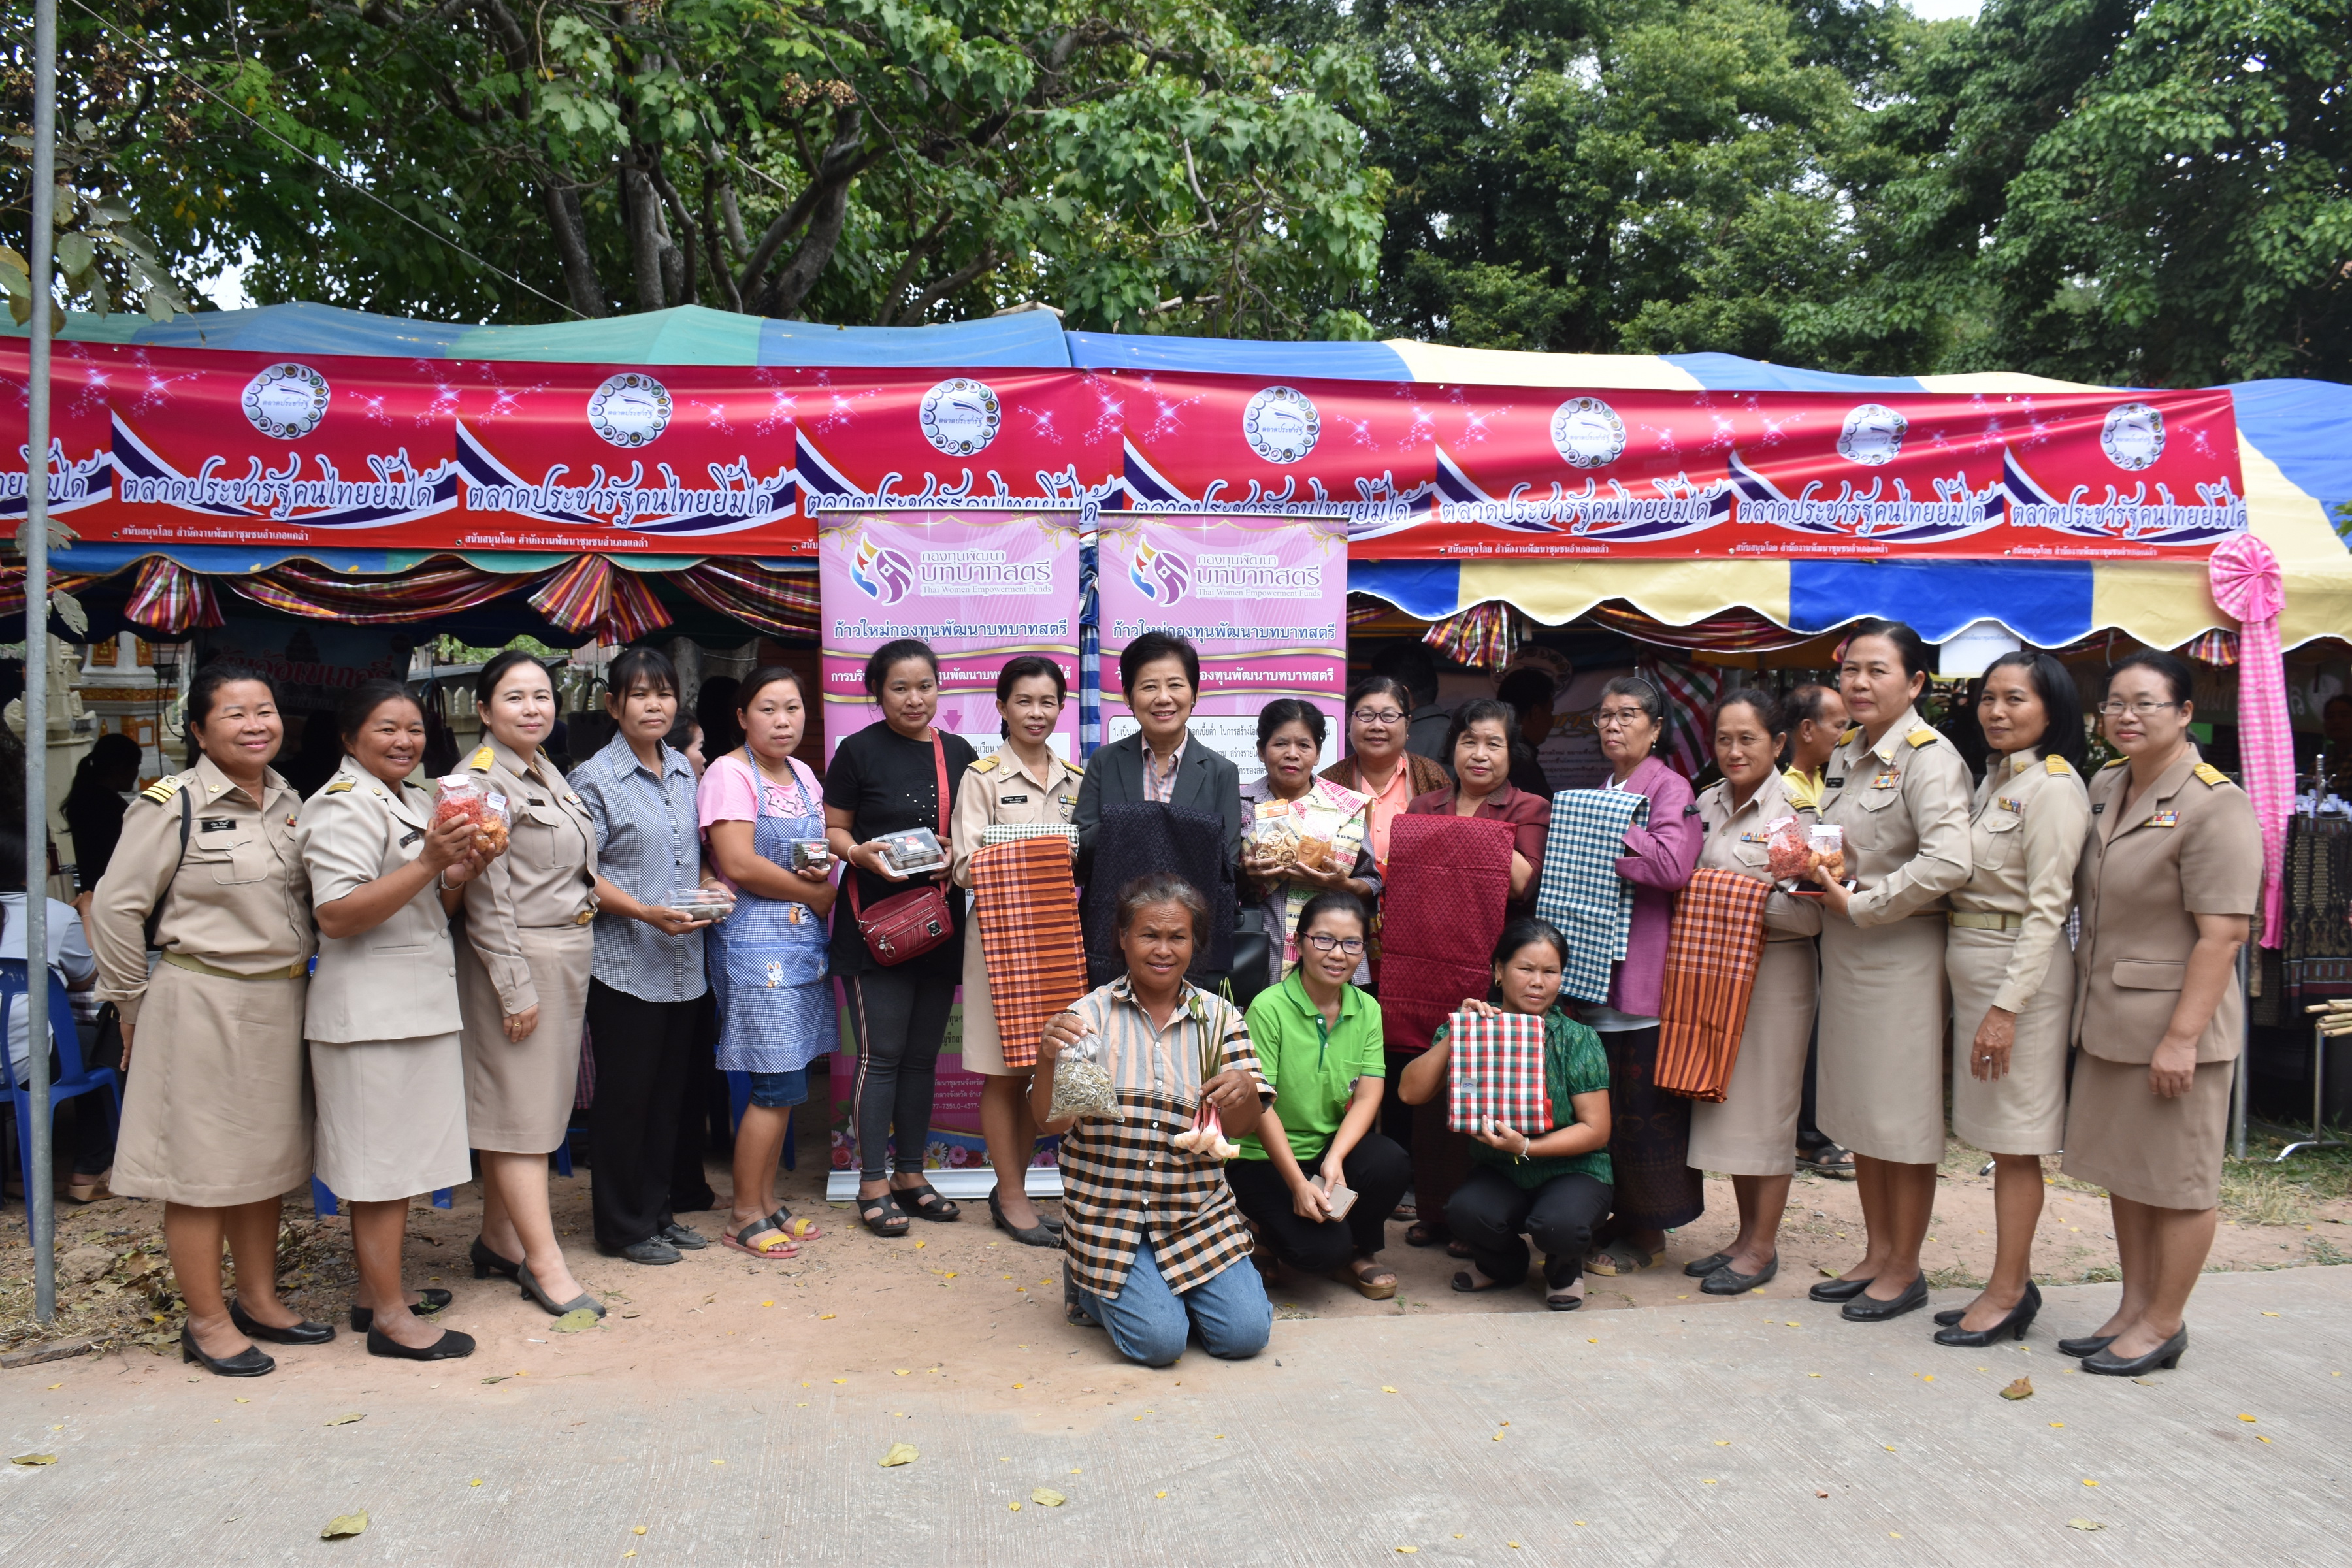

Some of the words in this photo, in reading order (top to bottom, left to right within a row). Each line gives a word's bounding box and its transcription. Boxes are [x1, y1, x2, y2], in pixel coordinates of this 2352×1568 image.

[122, 448, 448, 519] ตลาดประชารัฐคนไทยยิ้มได้
[465, 458, 787, 527] ตลาดประชารัฐคนไทยยิ้มได้
[1441, 472, 1724, 535] ตลาดประชารัฐคนไทยยิ้มได้
[1737, 472, 1997, 537] ตลาดประชารัฐคนไทยยิ้มได้
[122, 525, 174, 539] สนับสนุนโดย
[465, 533, 515, 547] สนับสนุนโดย
[921, 550, 1005, 564] กองทุนพัฒนา
[1447, 542, 1493, 556] สนับสนุนโดย
[1197, 554, 1277, 568] กองทุนพัฒนา
[919, 561, 1052, 582] บทบาทสตรี
[1195, 564, 1322, 587] บทบาทสตรี
[922, 585, 940, 594] Thai
[941, 585, 970, 594] Women
[972, 585, 1026, 595] Empowerment
[1028, 585, 1052, 593] Funds
[1245, 589, 1298, 598] Empowerment
[833, 618, 1069, 642] ก้าวใหม่กองทุนพัฒนาบทบาทสตรี
